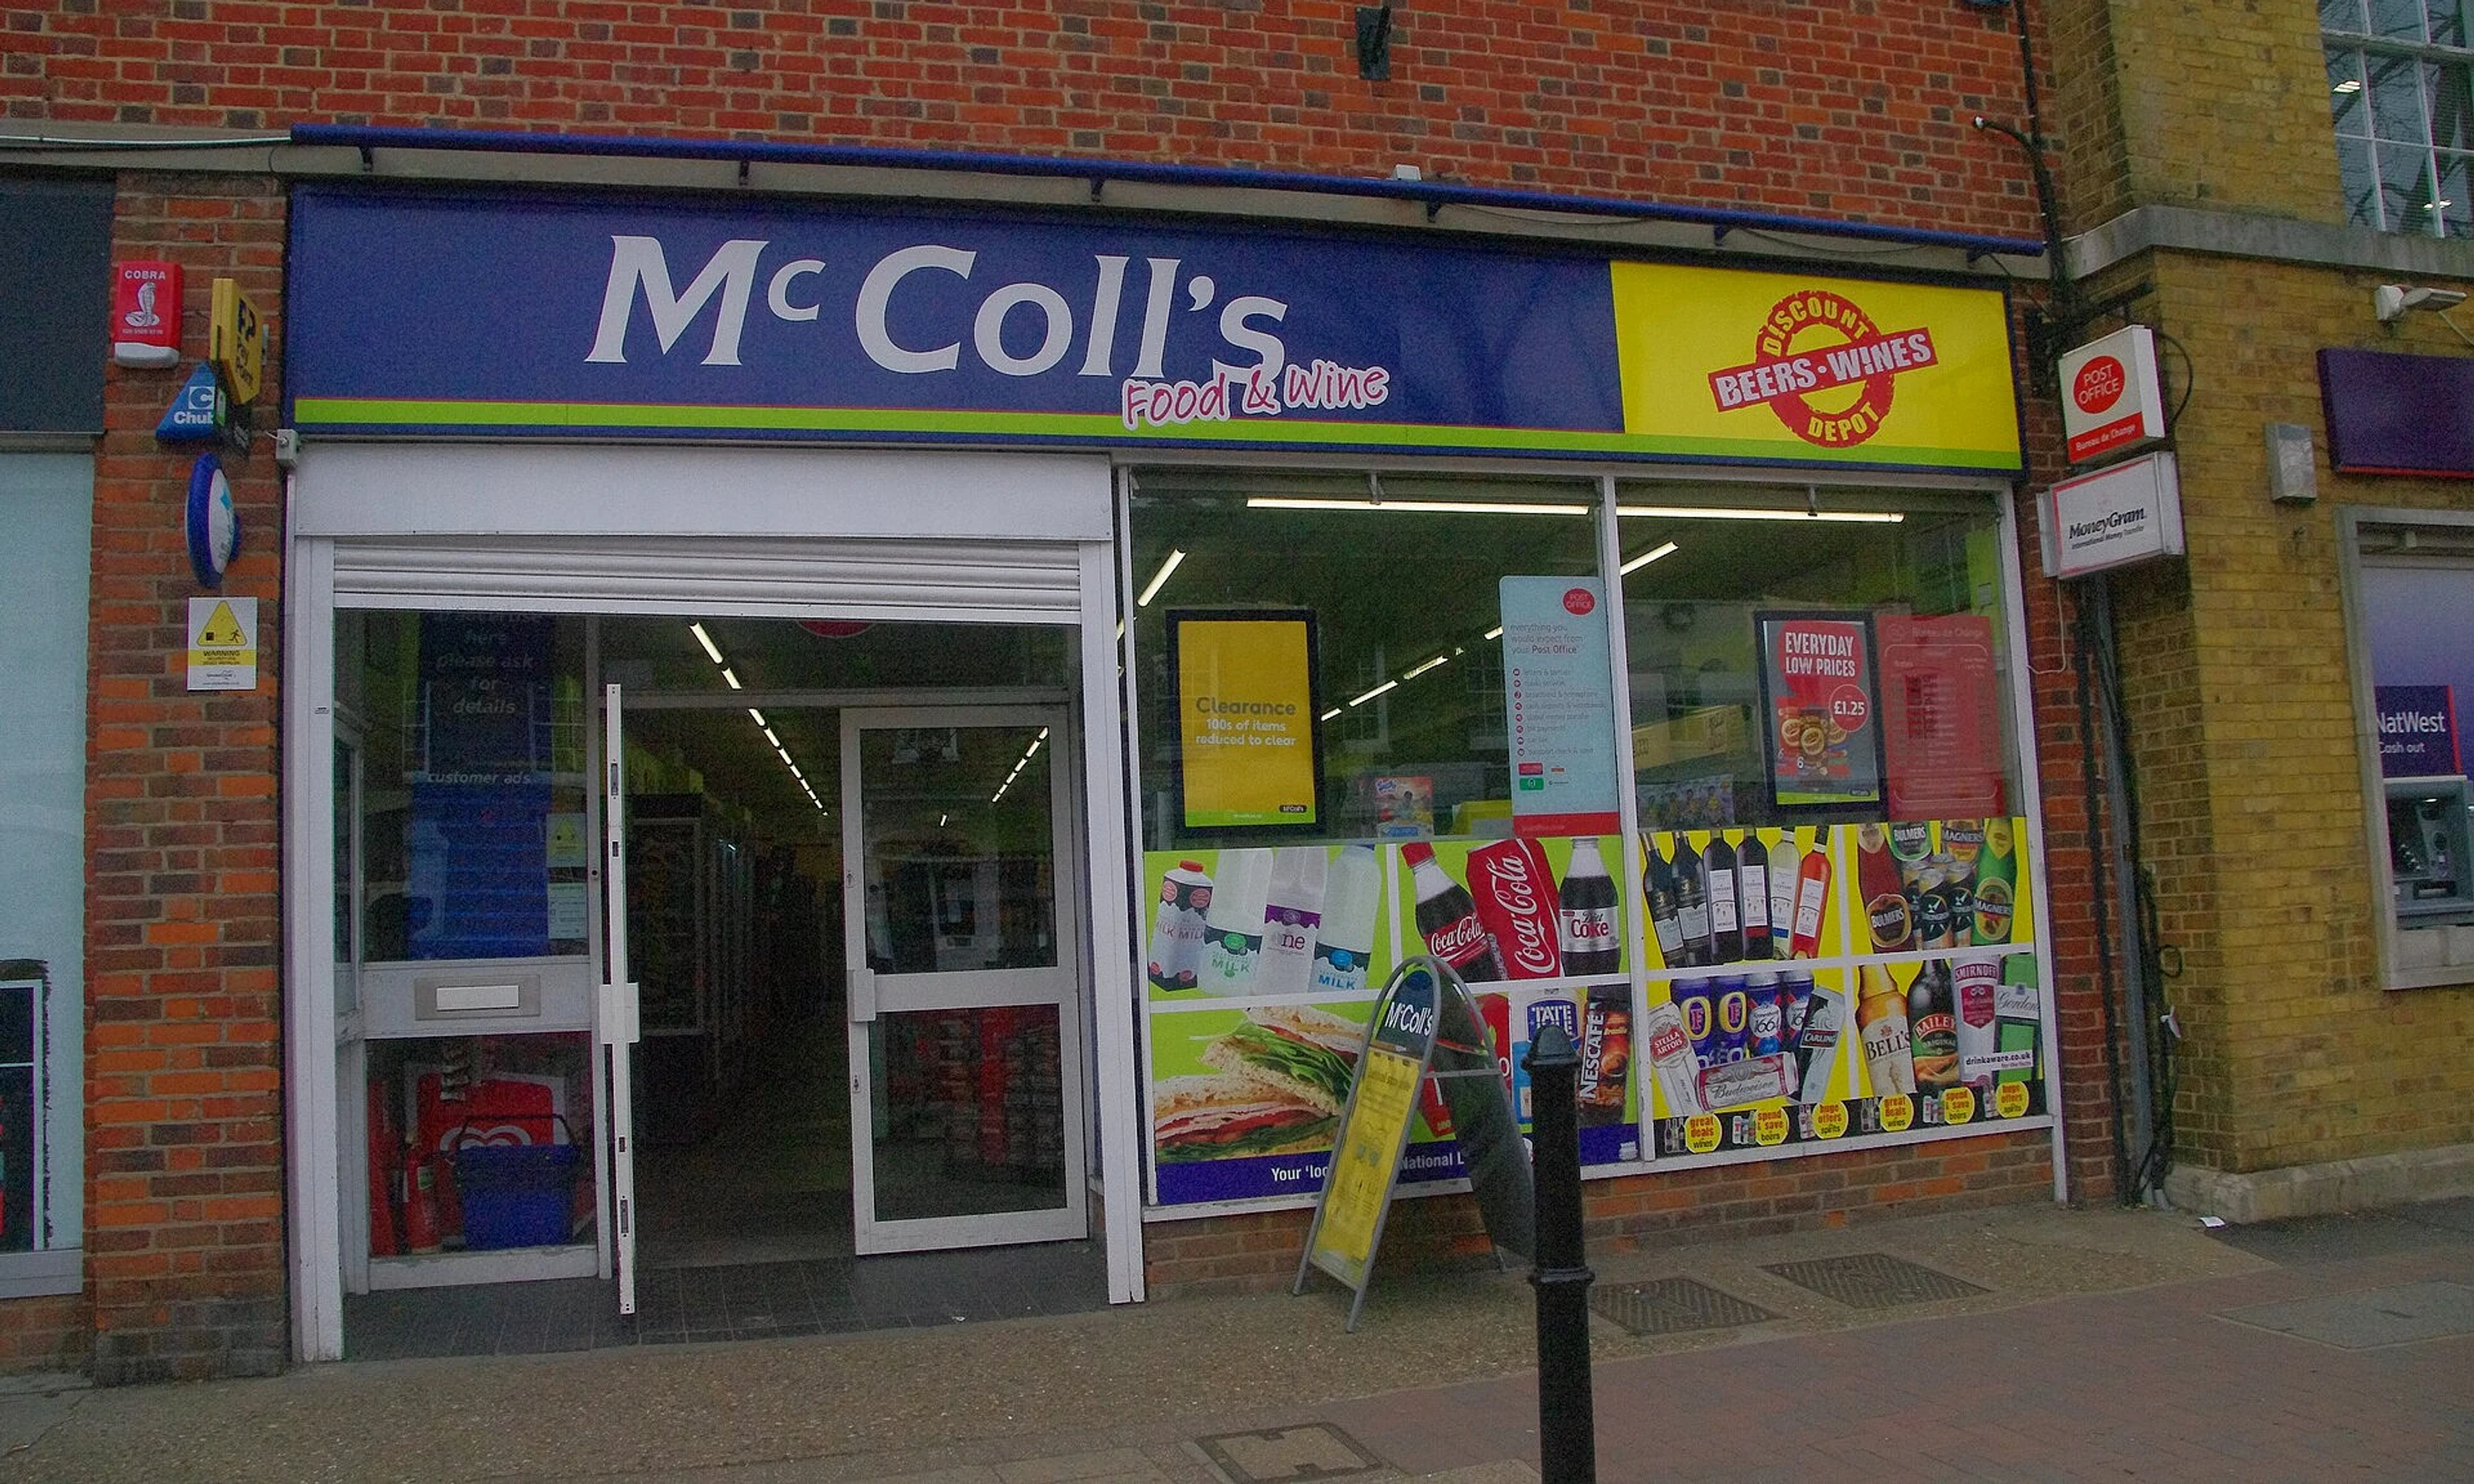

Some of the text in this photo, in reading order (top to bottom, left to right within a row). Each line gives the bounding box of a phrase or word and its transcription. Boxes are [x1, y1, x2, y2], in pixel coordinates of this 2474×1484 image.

[124, 270, 166, 280] COBRA
[1716, 358, 1817, 407] BEERS
[2084, 364, 2112, 387] POST
[1127, 365, 1388, 426] Food & Wine
[2078, 377, 2120, 404] OFFICE
[1808, 403, 1879, 442] DEPOT
[2069, 508, 2145, 539] MoneyGram
[1531, 645, 1550, 654] Post
[1553, 645, 1577, 654] Office
[1785, 632, 1854, 656] EVERYDAY
[1785, 657, 1856, 677] LOW PRICES
[470, 676, 499, 691] for
[454, 698, 516, 714] details
[1196, 697, 1296, 715] Clearance
[1834, 701, 1865, 716] £1.25
[1206, 719, 1287, 732] 100s of items
[2379, 712, 2446, 733] NatWest
[1196, 733, 1296, 747] reduced to clear
[2406, 742, 2425, 753] out
[427, 771, 532, 785] customer ads
[1894, 827, 1926, 841] BULMERS
[1486, 855, 1555, 973] Coca-Cola
[1871, 909, 1904, 928] BULMERS
[1157, 922, 1174, 937] ILK
[1431, 913, 1485, 957] Coca-Cola
[1571, 918, 1609, 938] Coke
[1211, 958, 1250, 974] MILK
[1955, 964, 1998, 980] SMIRNOFF
[1318, 975, 1356, 990] MILK
[1384, 1002, 1434, 1036] McColl's
[1654, 1032, 1680, 1049] STELLA
[1805, 1032, 1836, 1043] CARLING
[1865, 1030, 1911, 1060] BELL'S
[1657, 1038, 1683, 1056] ARTOIS
[1966, 1052, 2031, 1065] drinkaware.co.uk
[1690, 1116, 1714, 1127] great
[1757, 1111, 1782, 1122] spend
[1690, 1128, 1714, 1138] deals
[1765, 1120, 1784, 1130] save
[1271, 1167, 1301, 1182] Your
[1305, 1164, 1327, 1179] 'loc
